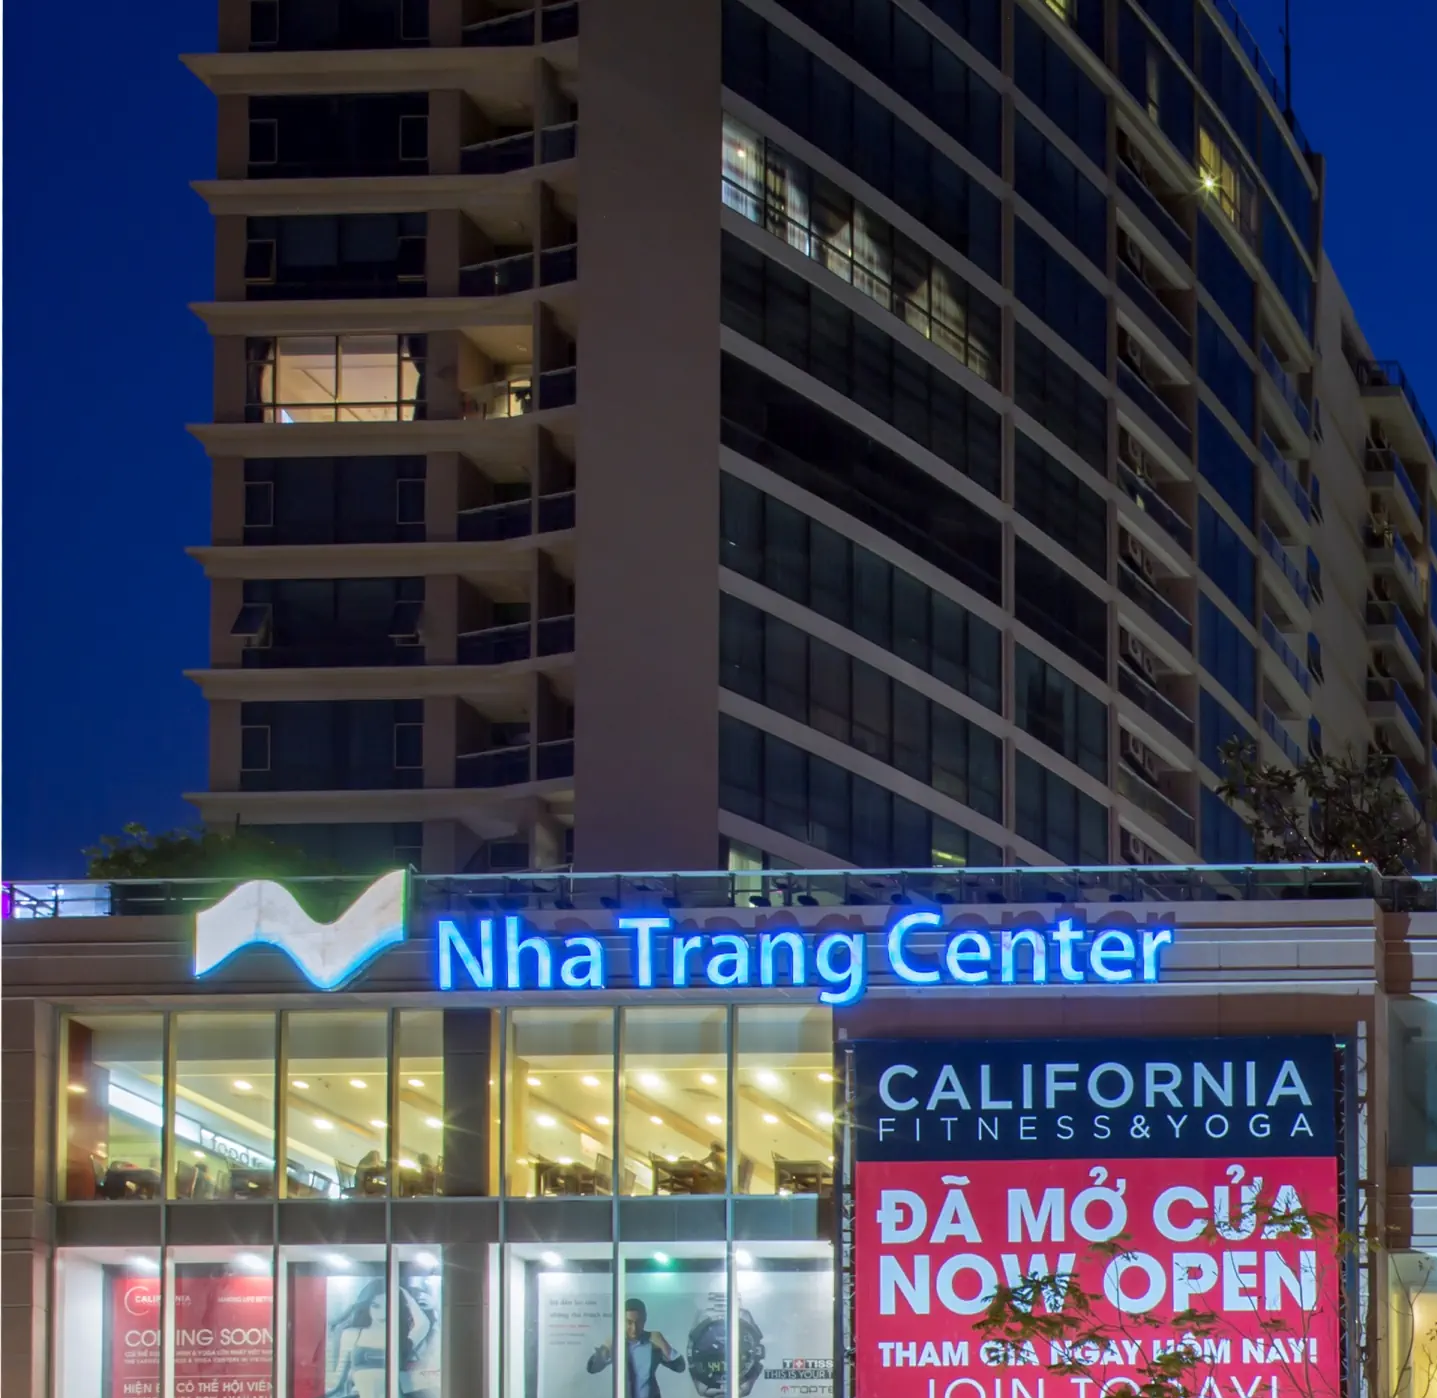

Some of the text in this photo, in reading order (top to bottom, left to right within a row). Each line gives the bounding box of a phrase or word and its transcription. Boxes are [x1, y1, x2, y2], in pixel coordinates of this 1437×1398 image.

[438, 911, 1174, 1004] Nha Trang Center
[878, 1060, 1313, 1112] CALIFORNIA
[876, 1164, 1314, 1245] ĐÃ MỞ CỬA
[879, 1250, 1318, 1316] NOW OPEN
[878, 1342, 970, 1368] THAM
[979, 1340, 1040, 1368] GIA
[1050, 1339, 1143, 1367] NGAY
[1241, 1337, 1319, 1365] NAY!
